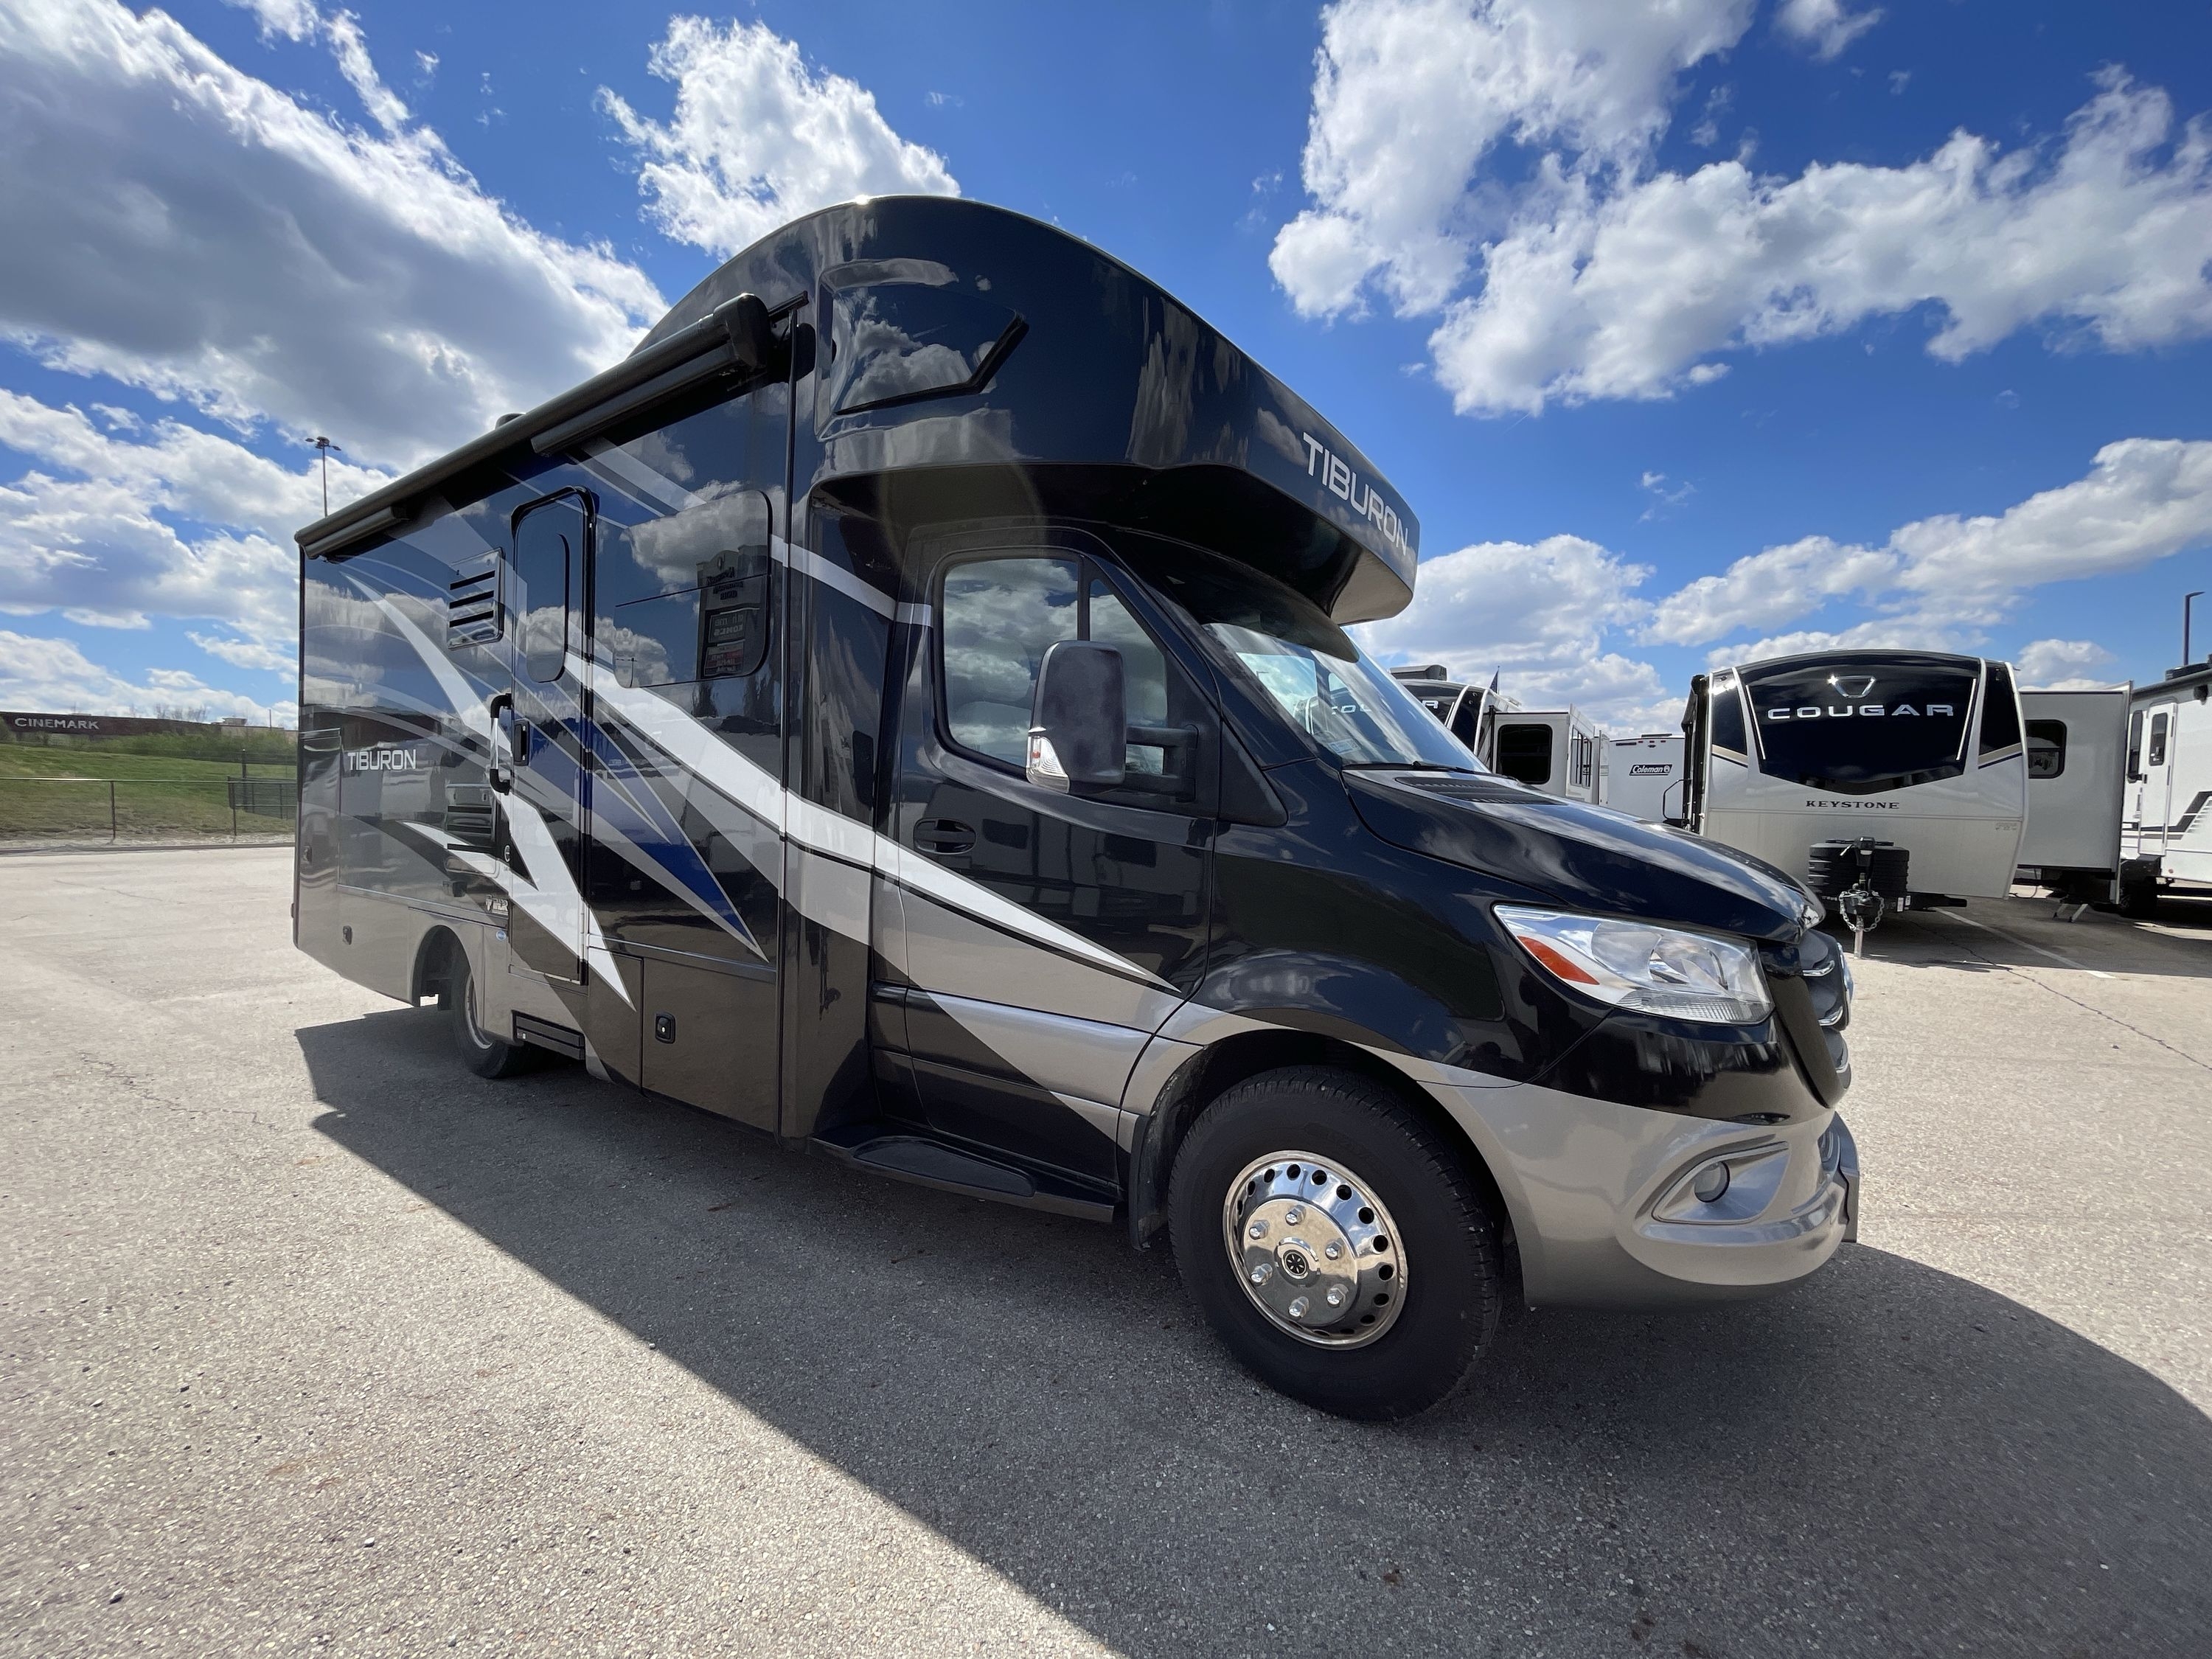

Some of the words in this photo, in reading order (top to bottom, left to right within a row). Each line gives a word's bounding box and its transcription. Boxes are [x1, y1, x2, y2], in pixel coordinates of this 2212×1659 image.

[1303, 432, 1408, 556] TIBURON
[1767, 704, 1954, 720] COUGAR
[15, 717, 100, 729] CINEMARK
[347, 749, 416, 770] TIBURON
[1806, 800, 1900, 810] KEYSTONE
